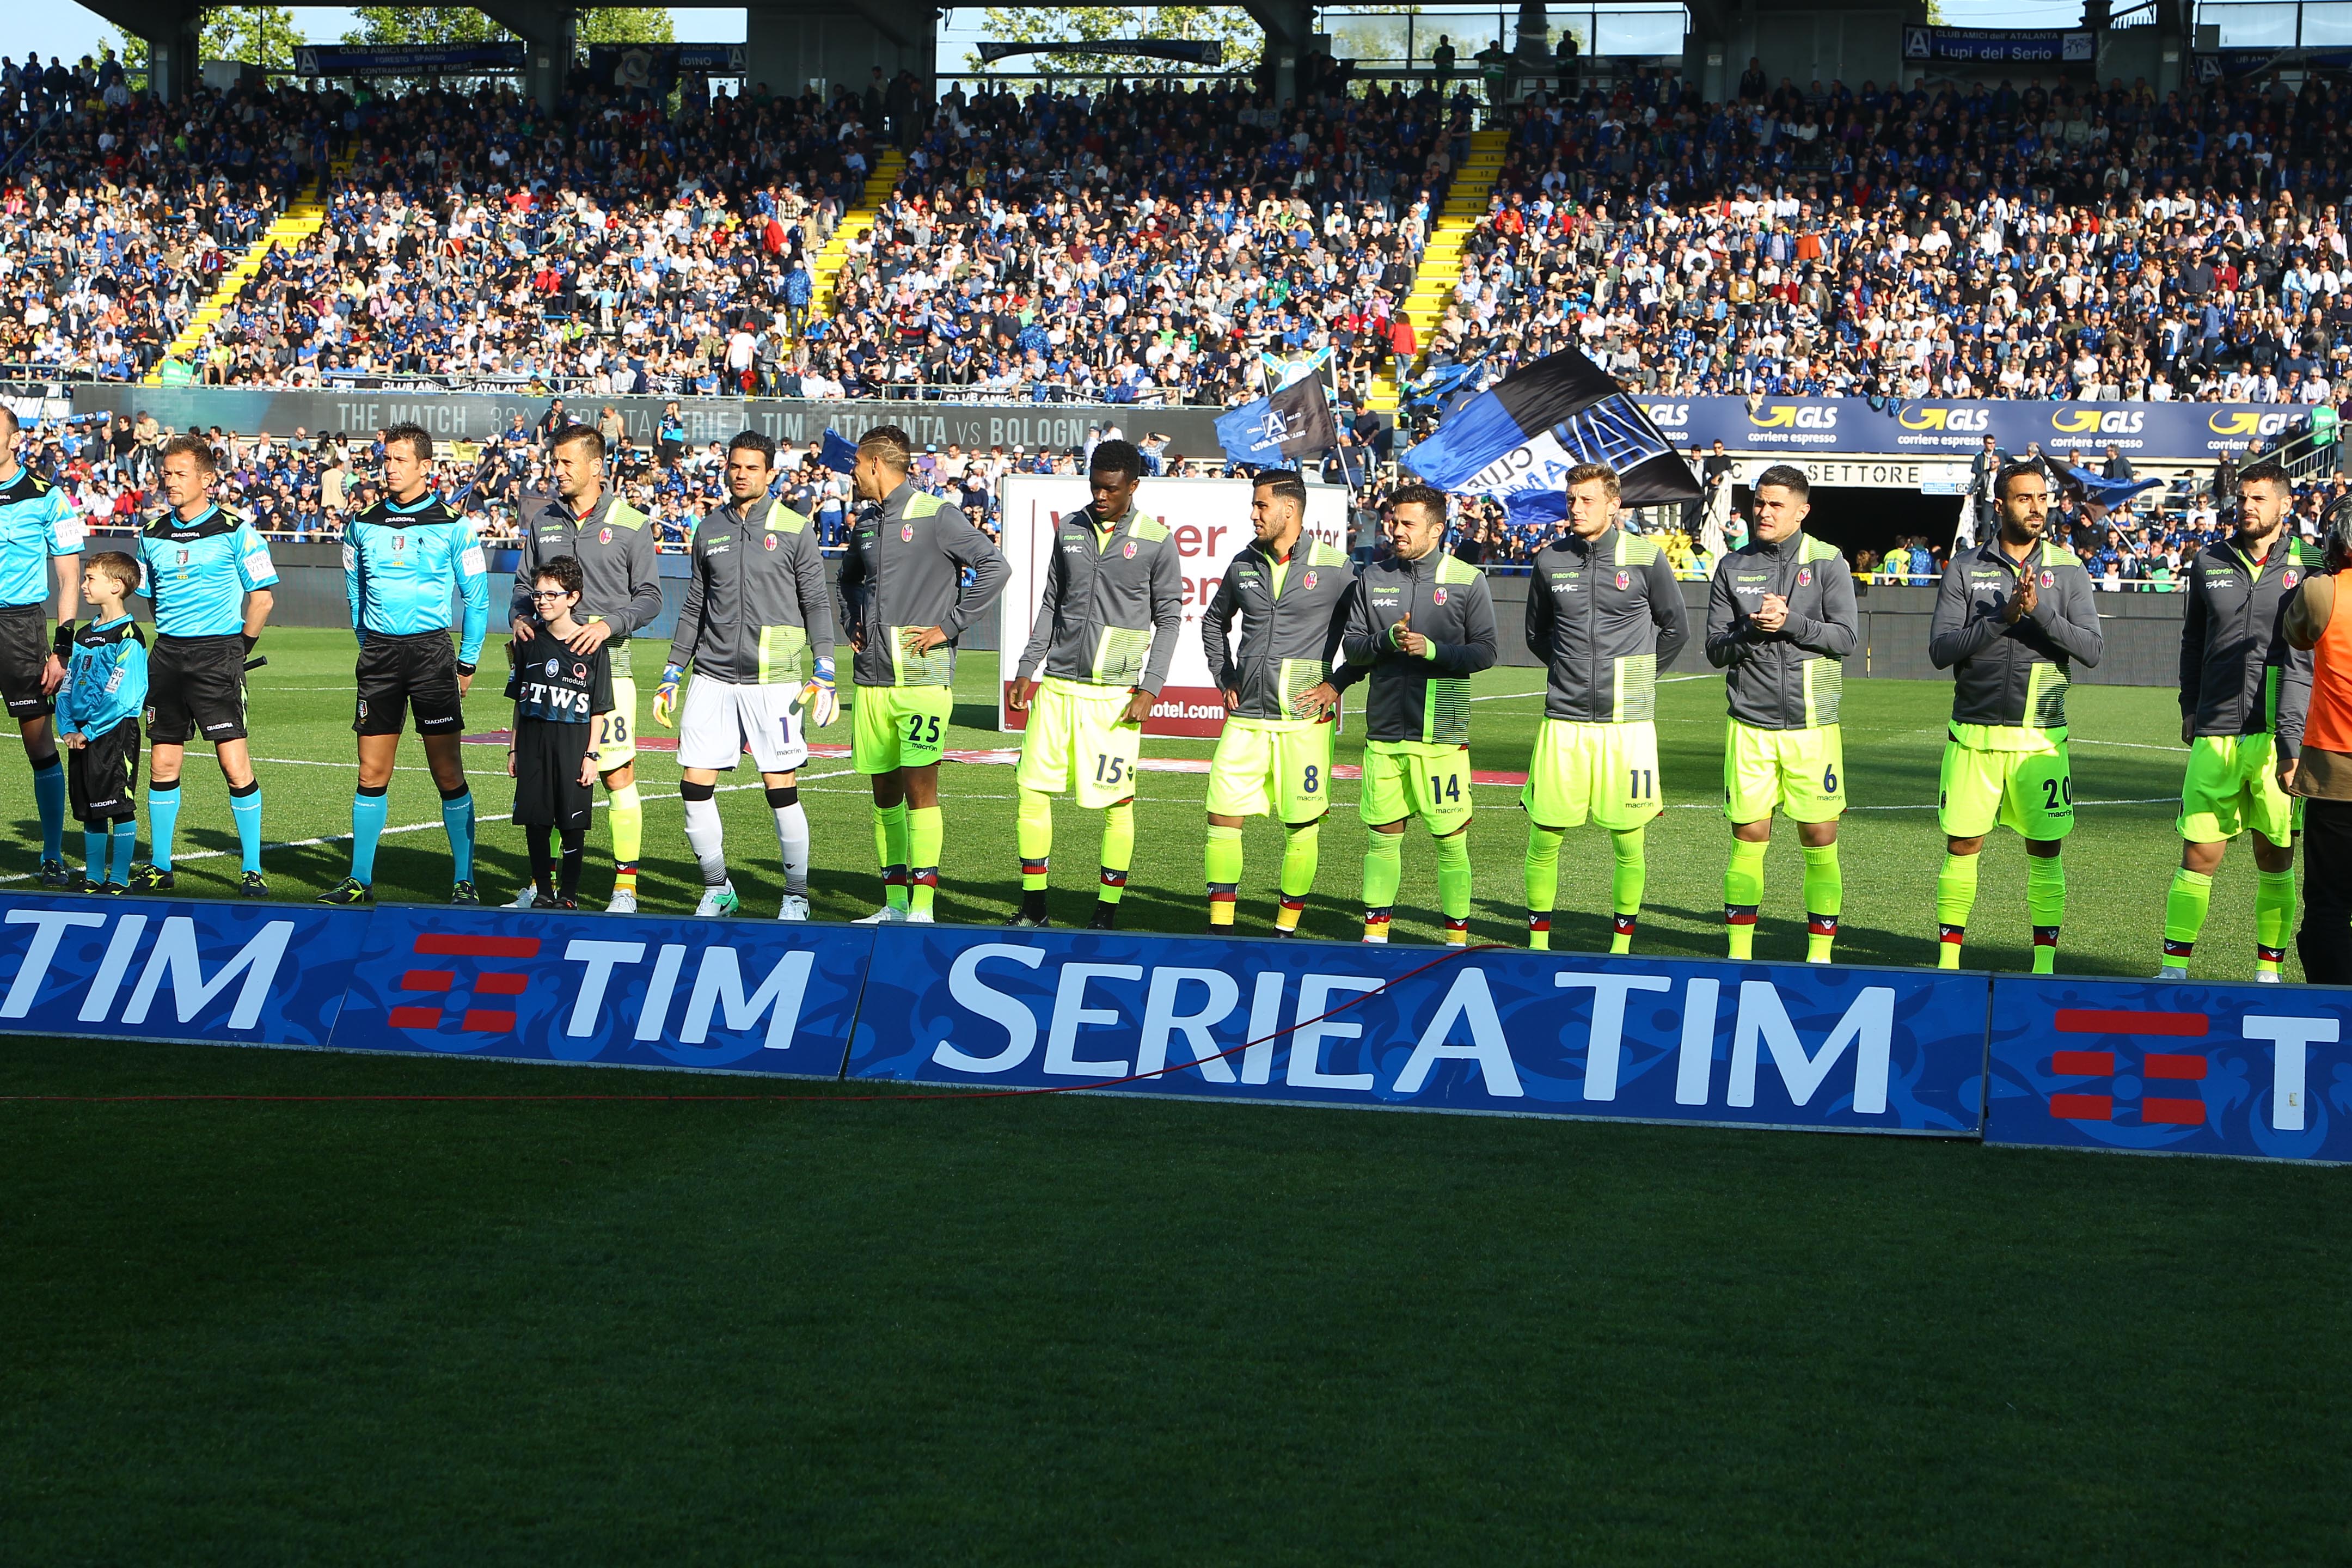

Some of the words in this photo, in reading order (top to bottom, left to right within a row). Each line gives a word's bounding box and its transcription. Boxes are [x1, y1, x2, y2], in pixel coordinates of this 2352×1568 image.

[1936, 30, 1960, 38] CLUB
[1962, 30, 1987, 39] AMICI
[339, 47, 367, 55] CLUB
[370, 46, 400, 54] AMICI
[1940, 44, 1973, 59] Lupi
[1981, 47, 2003, 59] del
[2012, 47, 2052, 60] Serio
[382, 381, 415, 391] CLUB
[946, 393, 978, 403] CLUB
[337, 403, 379, 431] THE
[389, 405, 467, 434] MATCH
[1648, 404, 1689, 426] GLS
[1796, 406, 1837, 428] GLS
[1946, 409, 1989, 431] GLS
[2100, 411, 2145, 434] GLS
[762, 413, 803, 442] TIM
[1662, 431, 1688, 441] resso
[1747, 431, 1788, 443] corriere
[1791, 433, 1837, 445] espresso
[1897, 433, 1939, 446] corriere
[2050, 436, 2093, 448] corriere
[1806, 464, 1919, 483] SETTORE
[56, 519, 77, 531] EURO
[59, 528, 79, 539] VITA
[246, 553, 267, 567] EURO
[250, 561, 271, 574] VITA
[1551, 584, 1578, 593] FAAC
[1736, 586, 1766, 595] FAAC
[1971, 582, 2001, 591] FAAC
[2205, 580, 2233, 589] FAAC
[111, 677, 119, 685] TA
[113, 669, 124, 677] RO
[530, 682, 590, 714] TWS
[206, 722, 234, 731] DIADORA
[425, 716, 454, 725] DIADORA
[599, 716, 627, 744] 28
[780, 716, 789, 743] 1
[908, 715, 940, 743] 25
[1097, 754, 1124, 783] 15
[1304, 765, 1318, 793] 8
[1631, 770, 1651, 799] 11
[1823, 763, 1837, 793] 6
[1431, 774, 1460, 805] 14
[2042, 775, 2072, 810] 20
[0, 909, 295, 1030] TIM
[564, 939, 815, 1049] TIM
[932, 942, 1386, 1091] SERIE
[1393, 967, 1524, 1098] A
[1555, 971, 1895, 1114] TIM
